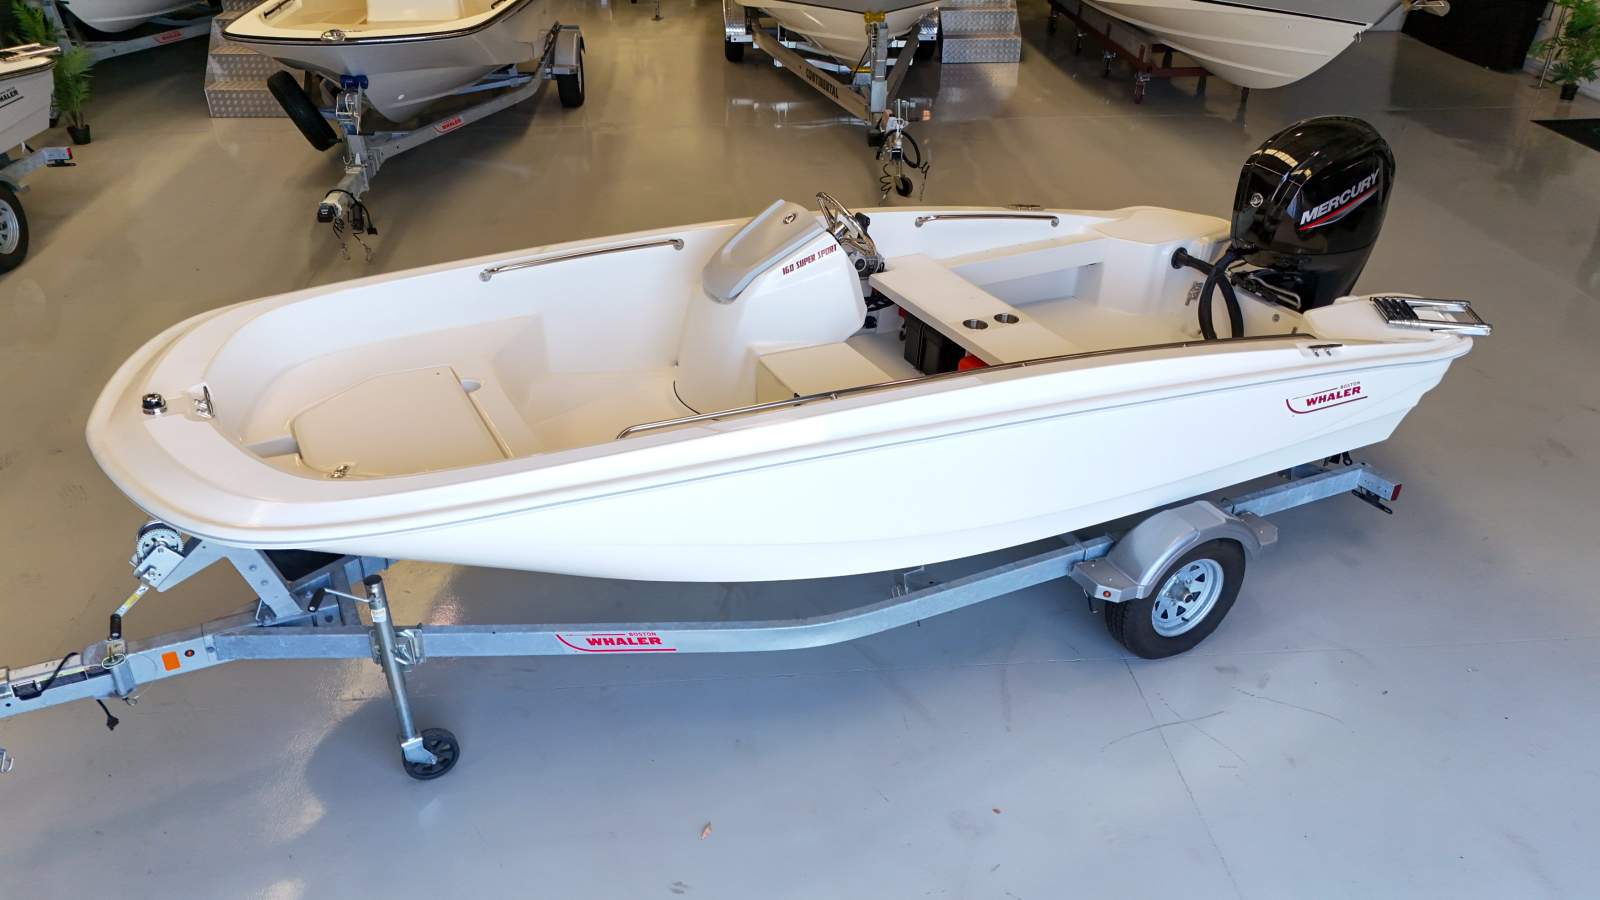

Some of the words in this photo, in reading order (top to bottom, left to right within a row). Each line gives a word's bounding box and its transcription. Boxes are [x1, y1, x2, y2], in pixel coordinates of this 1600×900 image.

[1300, 168, 1379, 225] MERCURY
[782, 263, 795, 276] 160
[795, 253, 816, 269] SUPER
[817, 244, 838, 260] SPORT
[1340, 381, 1361, 389] BOSTON
[1306, 386, 1361, 407] WHALER
[586, 637, 663, 646] WHALER
